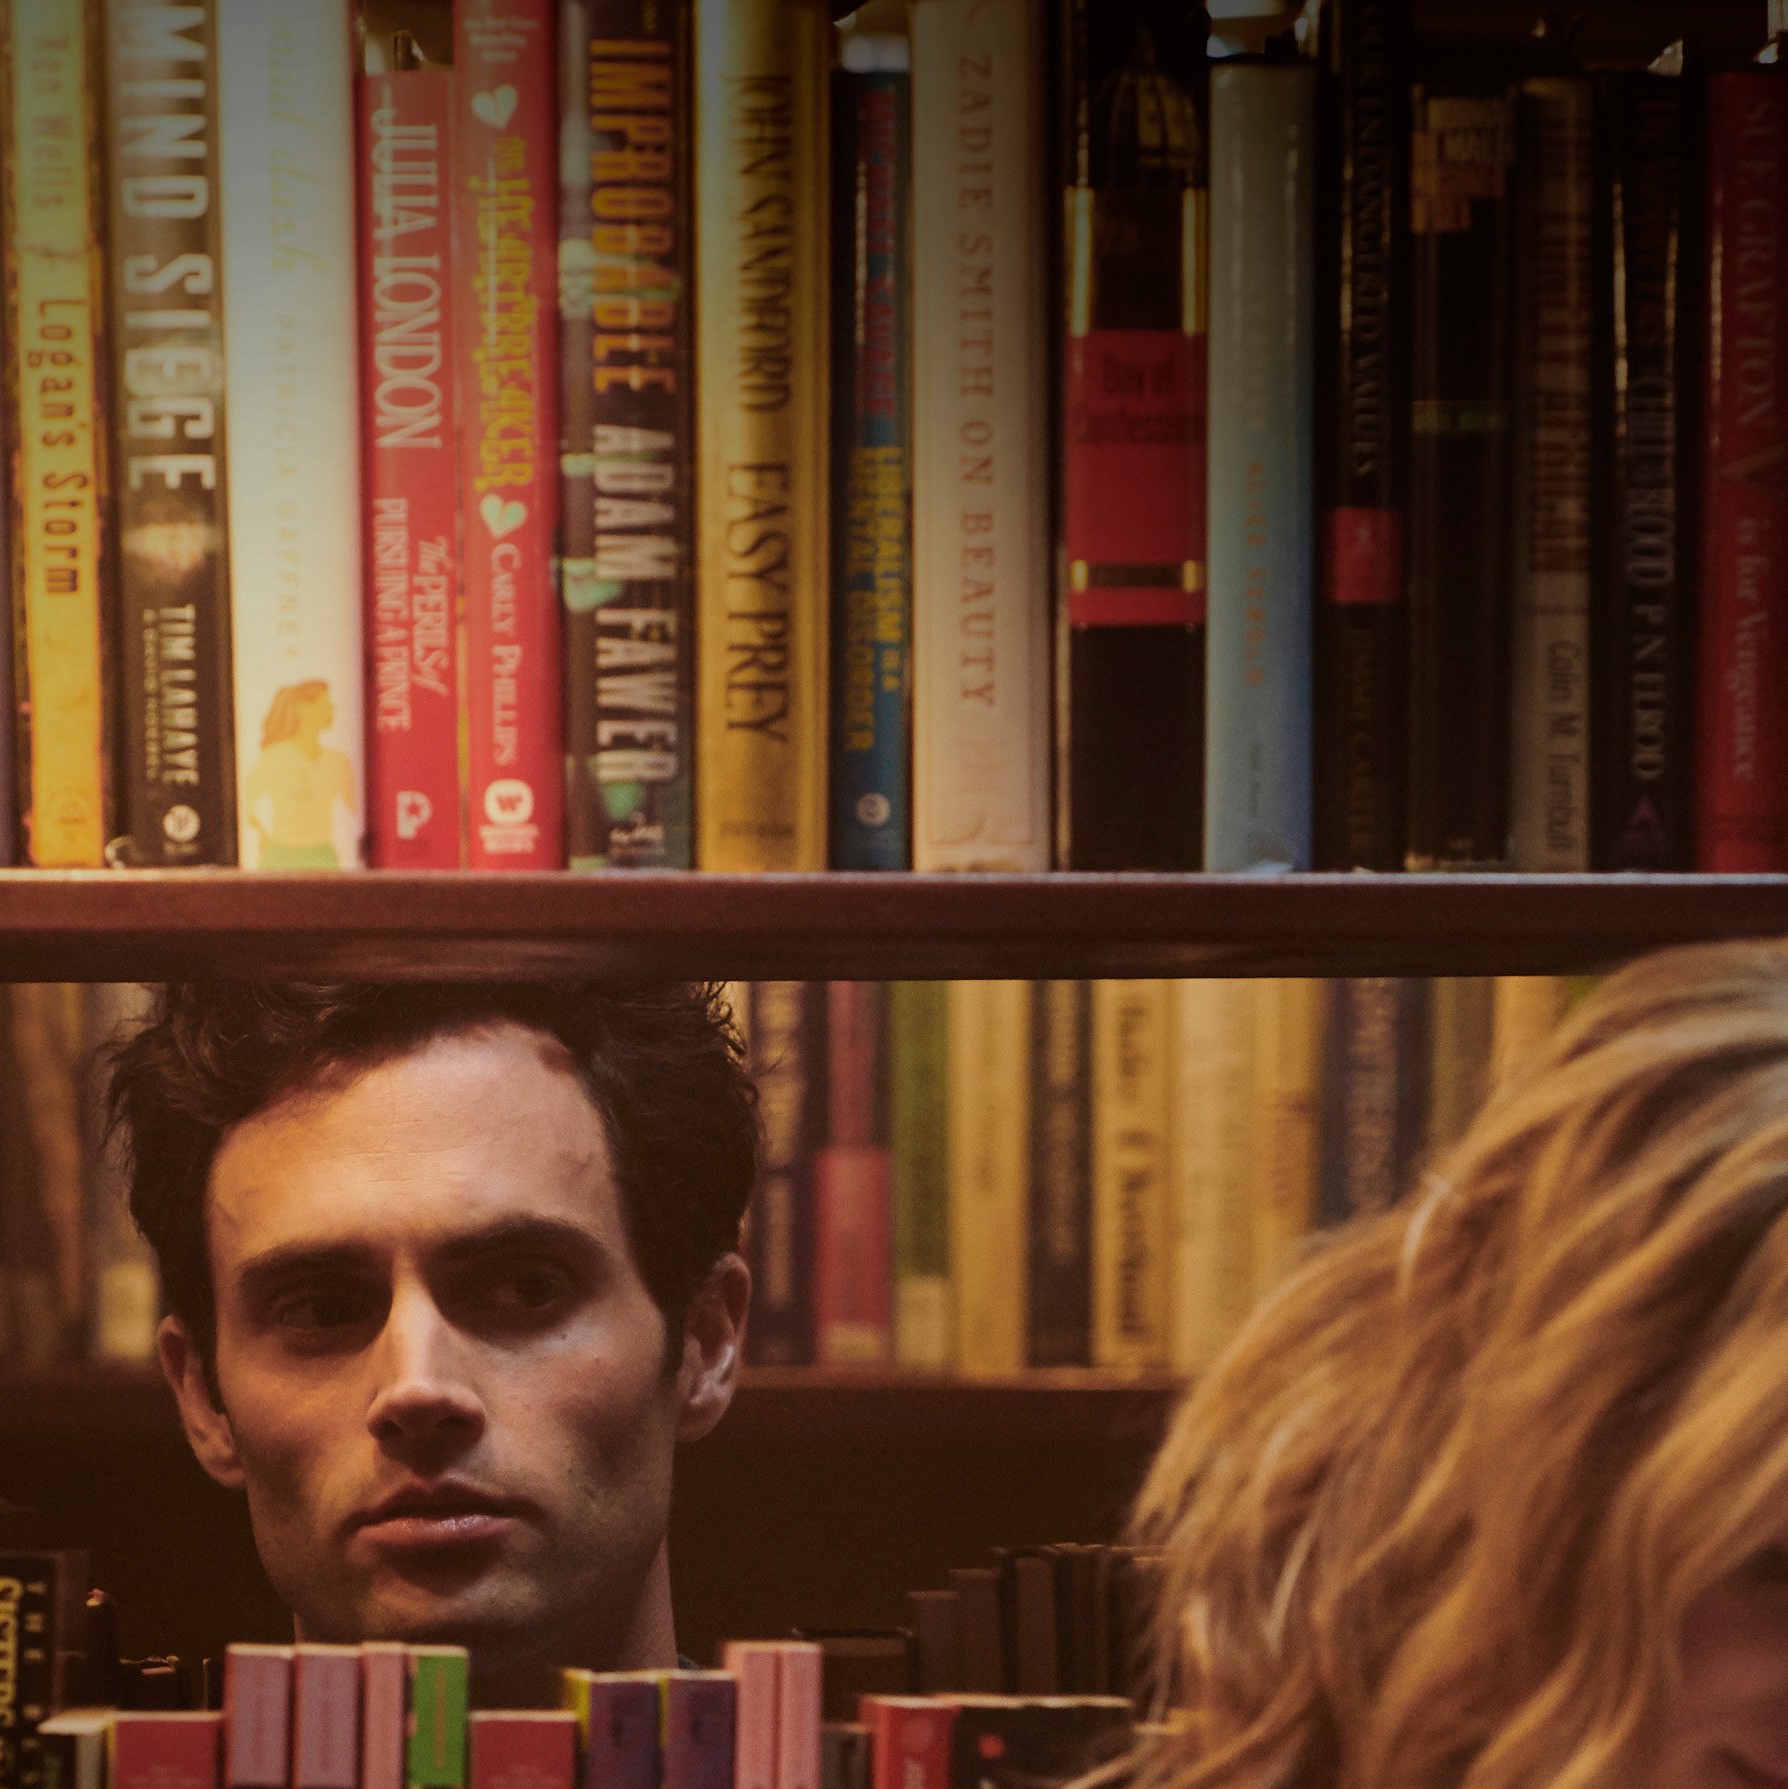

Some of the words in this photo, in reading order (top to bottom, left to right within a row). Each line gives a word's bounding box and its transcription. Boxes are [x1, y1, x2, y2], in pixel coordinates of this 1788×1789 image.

[116, 3, 210, 218] MIND
[1356, 5, 1384, 87] OUR
[33, 116, 73, 208] Wells
[369, 109, 441, 239] JULIA
[721, 73, 795, 178] JOHN
[959, 56, 995, 209] ZADIE
[1738, 99, 1776, 184] SUE
[269, 147, 326, 277] dash
[590, 40, 677, 395] IMPROBABLE
[1354, 96, 1383, 344] ENDANGERED
[373, 256, 443, 450] LONDON
[469, 173, 536, 494] HEARTBREAKER
[729, 193, 795, 413] SANDFORD
[864, 276, 898, 420] SAVAGE
[960, 234, 995, 399] SMITH
[1736, 198, 1777, 430] GRAFTON
[27, 298, 87, 446] Logan's
[119, 254, 214, 494] SIEGE
[272, 313, 302, 477] PATRICIA
[1352, 354, 1381, 477] VALUES
[591, 425, 677, 581] ADAM
[844, 447, 875, 577] MENTAL
[961, 420, 995, 487] ON
[1244, 459, 1265, 551] ALICE
[1722, 444, 1785, 485] V
[39, 471, 87, 597] Storm
[273, 502, 302, 661] GAFFNEY
[373, 497, 409, 622] PURSUING
[488, 543, 521, 636] CARLY
[723, 460, 791, 597] EASY
[873, 446, 904, 643] LIBERALISM
[1623, 486, 1674, 585] BLOOD
[1737, 555, 1769, 602] for
[1738, 516, 1769, 548] is
[157, 603, 198, 662] TIM
[411, 574, 450, 666] PERILS
[843, 590, 875, 751] DISORDER
[962, 513, 996, 710] BEAUTY
[1244, 568, 1266, 687] SEBOLD
[1546, 640, 1579, 704] Colin
[158, 669, 200, 786] LAHAYE
[375, 645, 412, 733] PRINCE
[488, 643, 521, 766] PHILLIPS
[593, 608, 678, 783] FAWER
[723, 613, 791, 746] PREY
[1631, 669, 1664, 781] ELROD
[1726, 609, 1766, 784] Vengeance
[1546, 750, 1579, 853] Turnbull
[22, 1582, 48, 1661] THE
